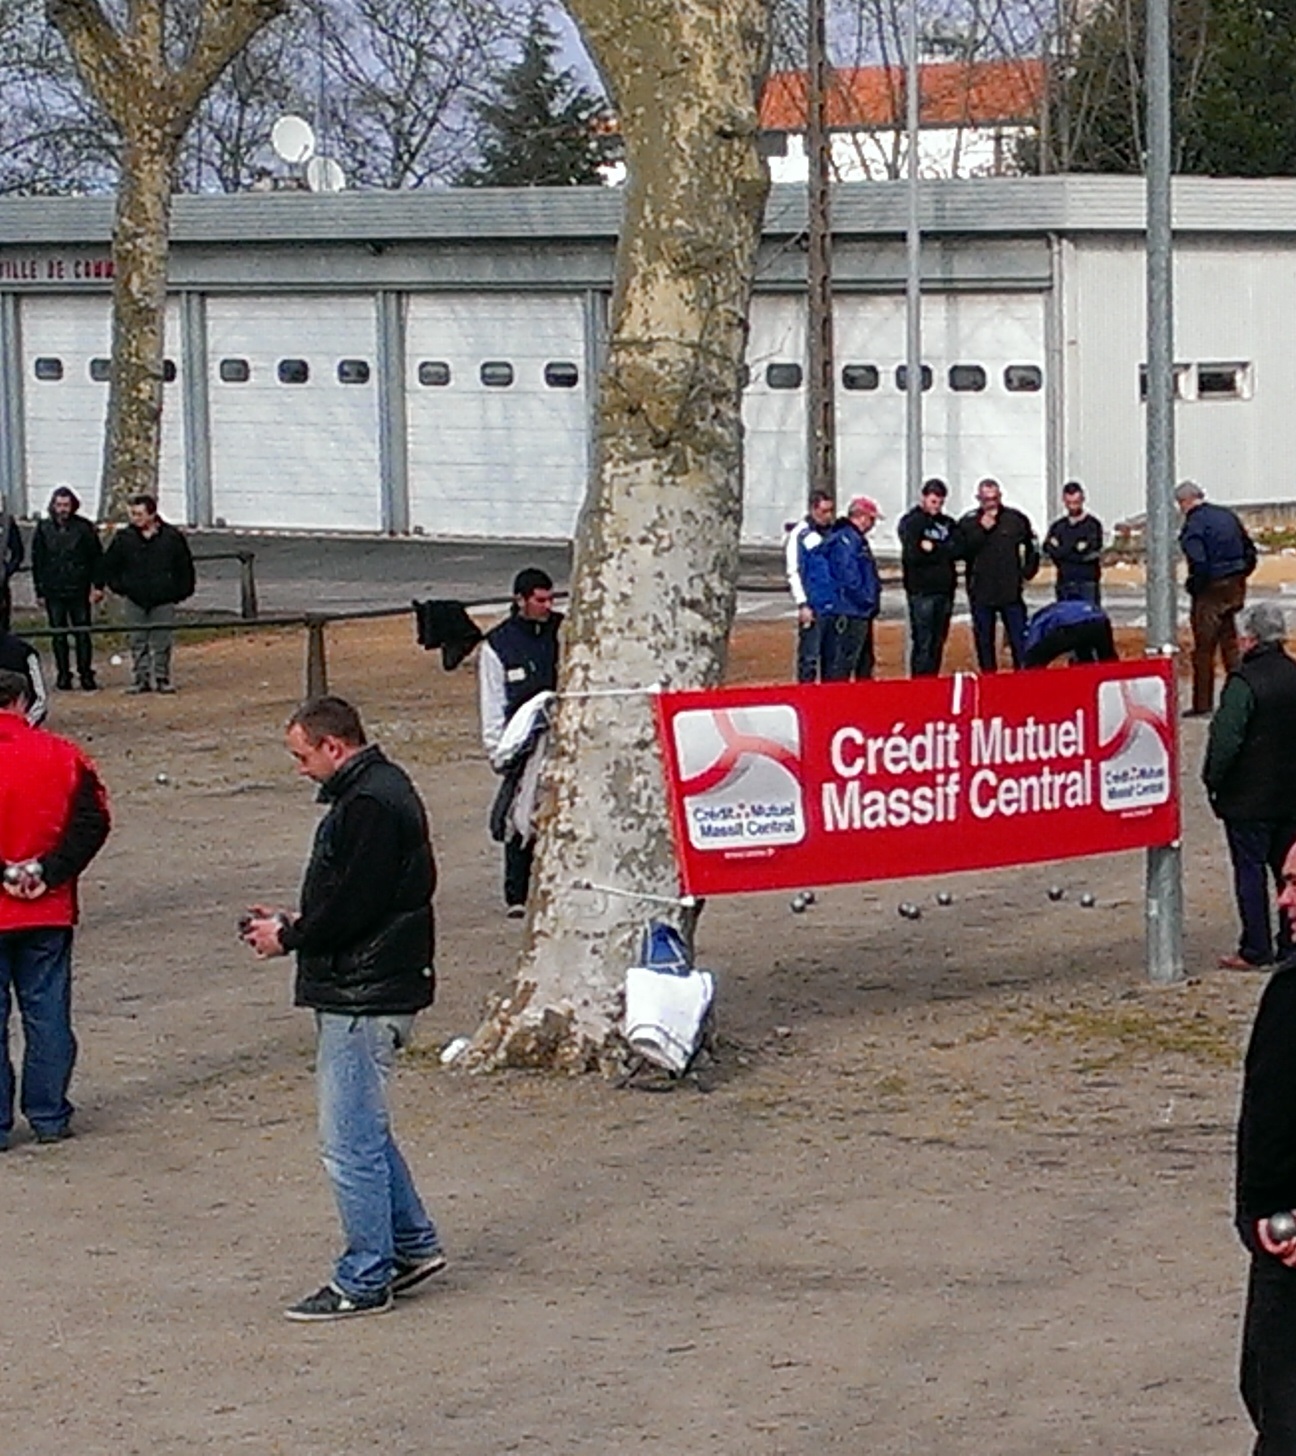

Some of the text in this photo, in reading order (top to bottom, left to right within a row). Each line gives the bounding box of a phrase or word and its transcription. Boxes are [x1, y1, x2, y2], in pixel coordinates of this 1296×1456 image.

[47, 259, 64, 279] DE
[74, 259, 115, 279] COMM
[830, 708, 1085, 778] Crédit Mutuel
[821, 758, 1092, 832] Massif Central
[693, 805, 735, 822] Crédit
[746, 818, 795, 836] Central
